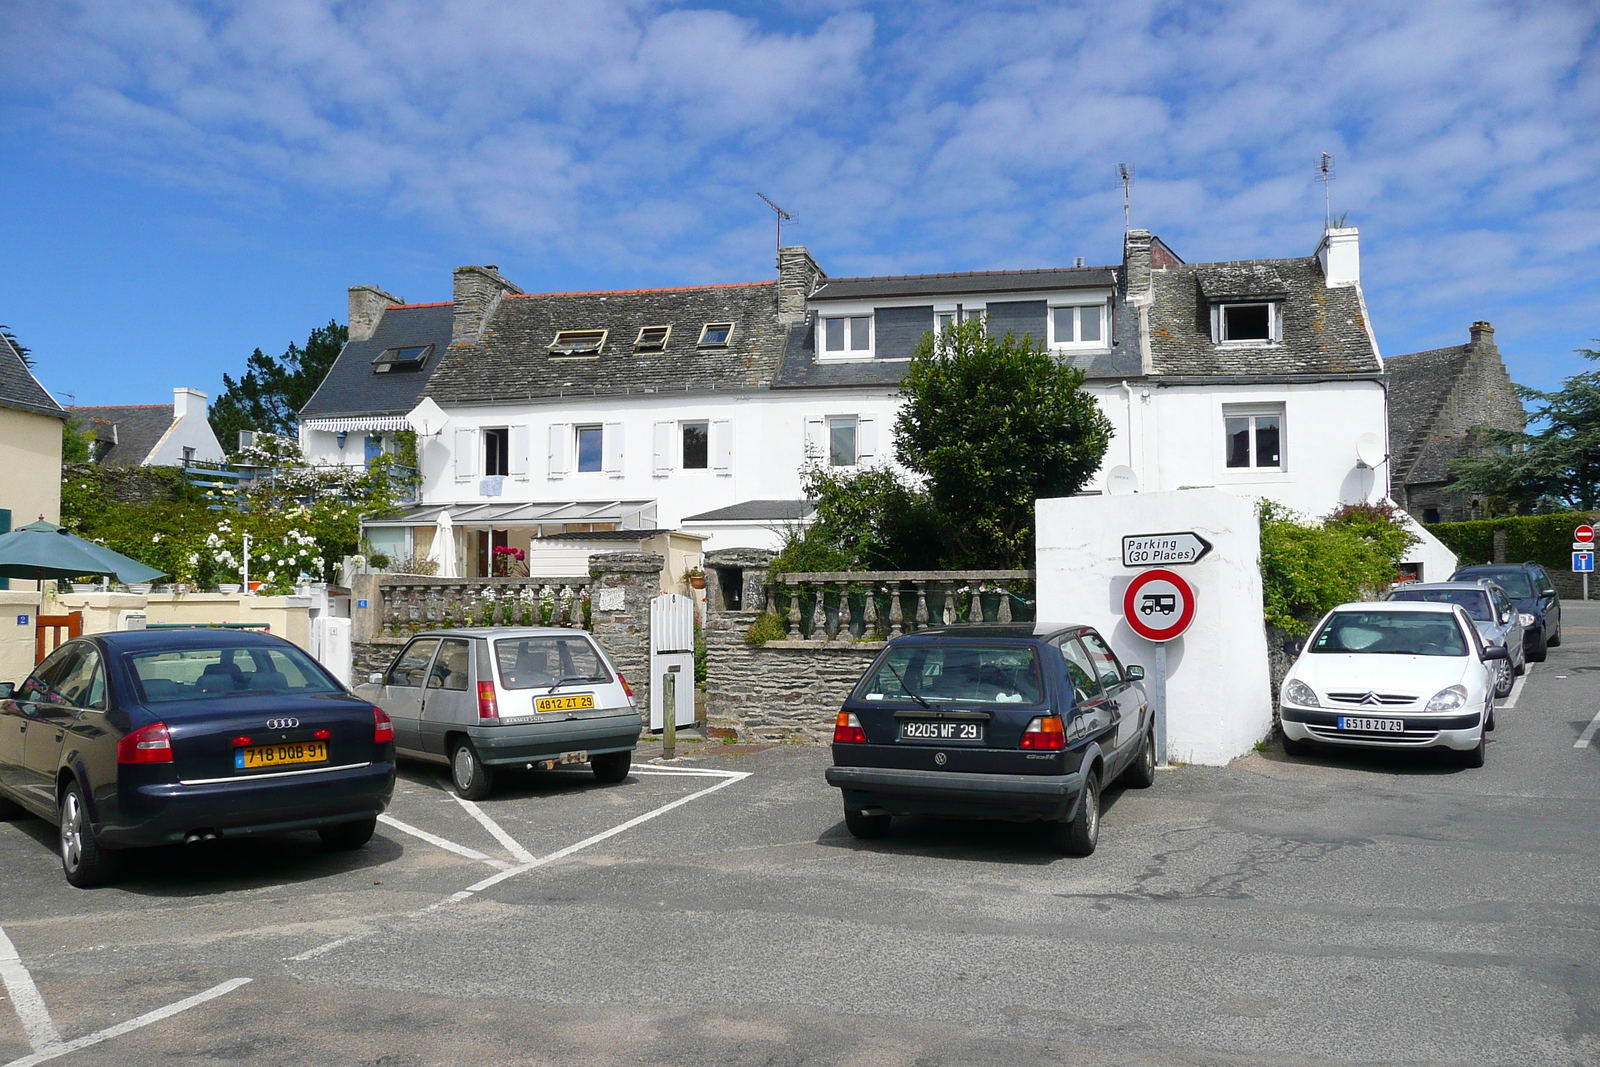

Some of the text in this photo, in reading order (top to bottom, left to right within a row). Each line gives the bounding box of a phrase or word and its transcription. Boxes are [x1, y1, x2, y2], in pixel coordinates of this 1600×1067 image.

[1128, 539, 1177, 551] Parking
[1129, 547, 1196, 562] (30 Places)
[20, 615, 26, 624] 2
[540, 696, 592, 710] 4812 ZT 29
[907, 722, 977, 738] 8205 WF 29
[1346, 718, 1371, 730] 6518
[1389, 720, 1401, 731] 29
[247, 748, 274, 764] 718
[278, 745, 304, 760] DQB
[308, 744, 324, 758] 91
